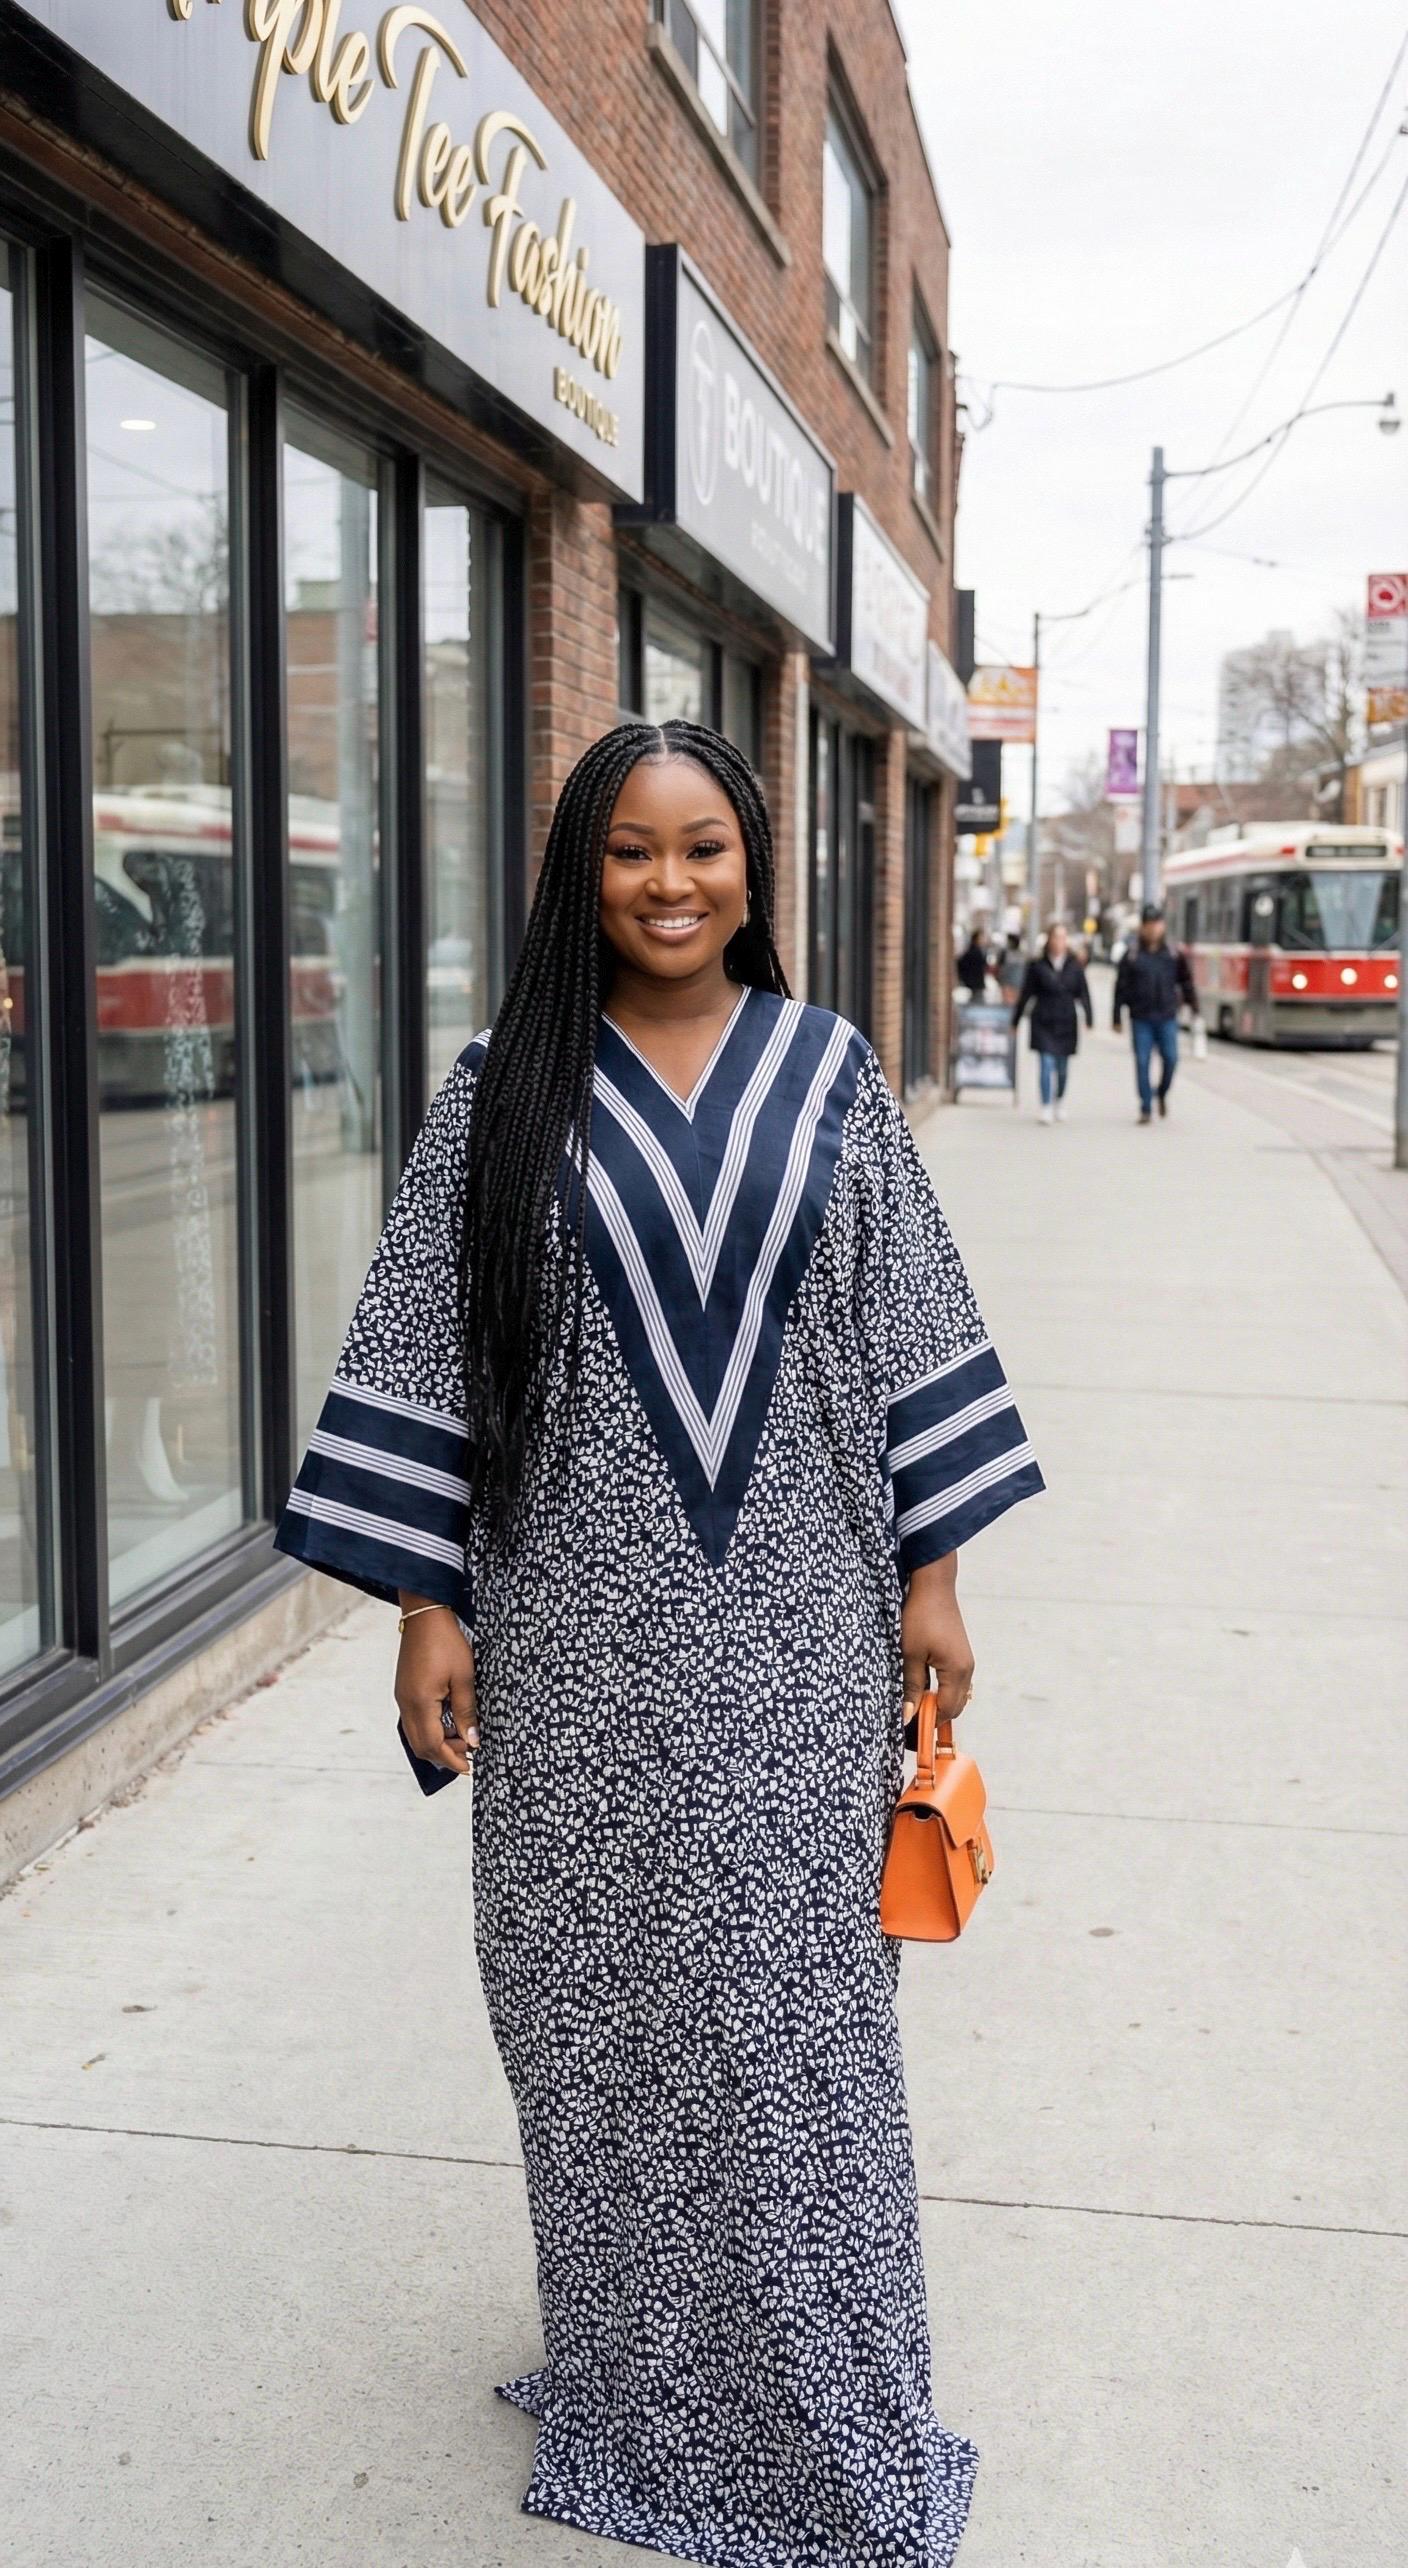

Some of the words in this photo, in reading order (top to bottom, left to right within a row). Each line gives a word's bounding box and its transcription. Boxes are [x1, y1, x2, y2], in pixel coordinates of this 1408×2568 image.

[167, 0, 375, 161] ple
[378, 4, 477, 228] Tee
[476, 110, 624, 380] Fashion
[554, 366, 621, 448] BOUTIQUE
[723, 370, 827, 566] BOUTIQUE
